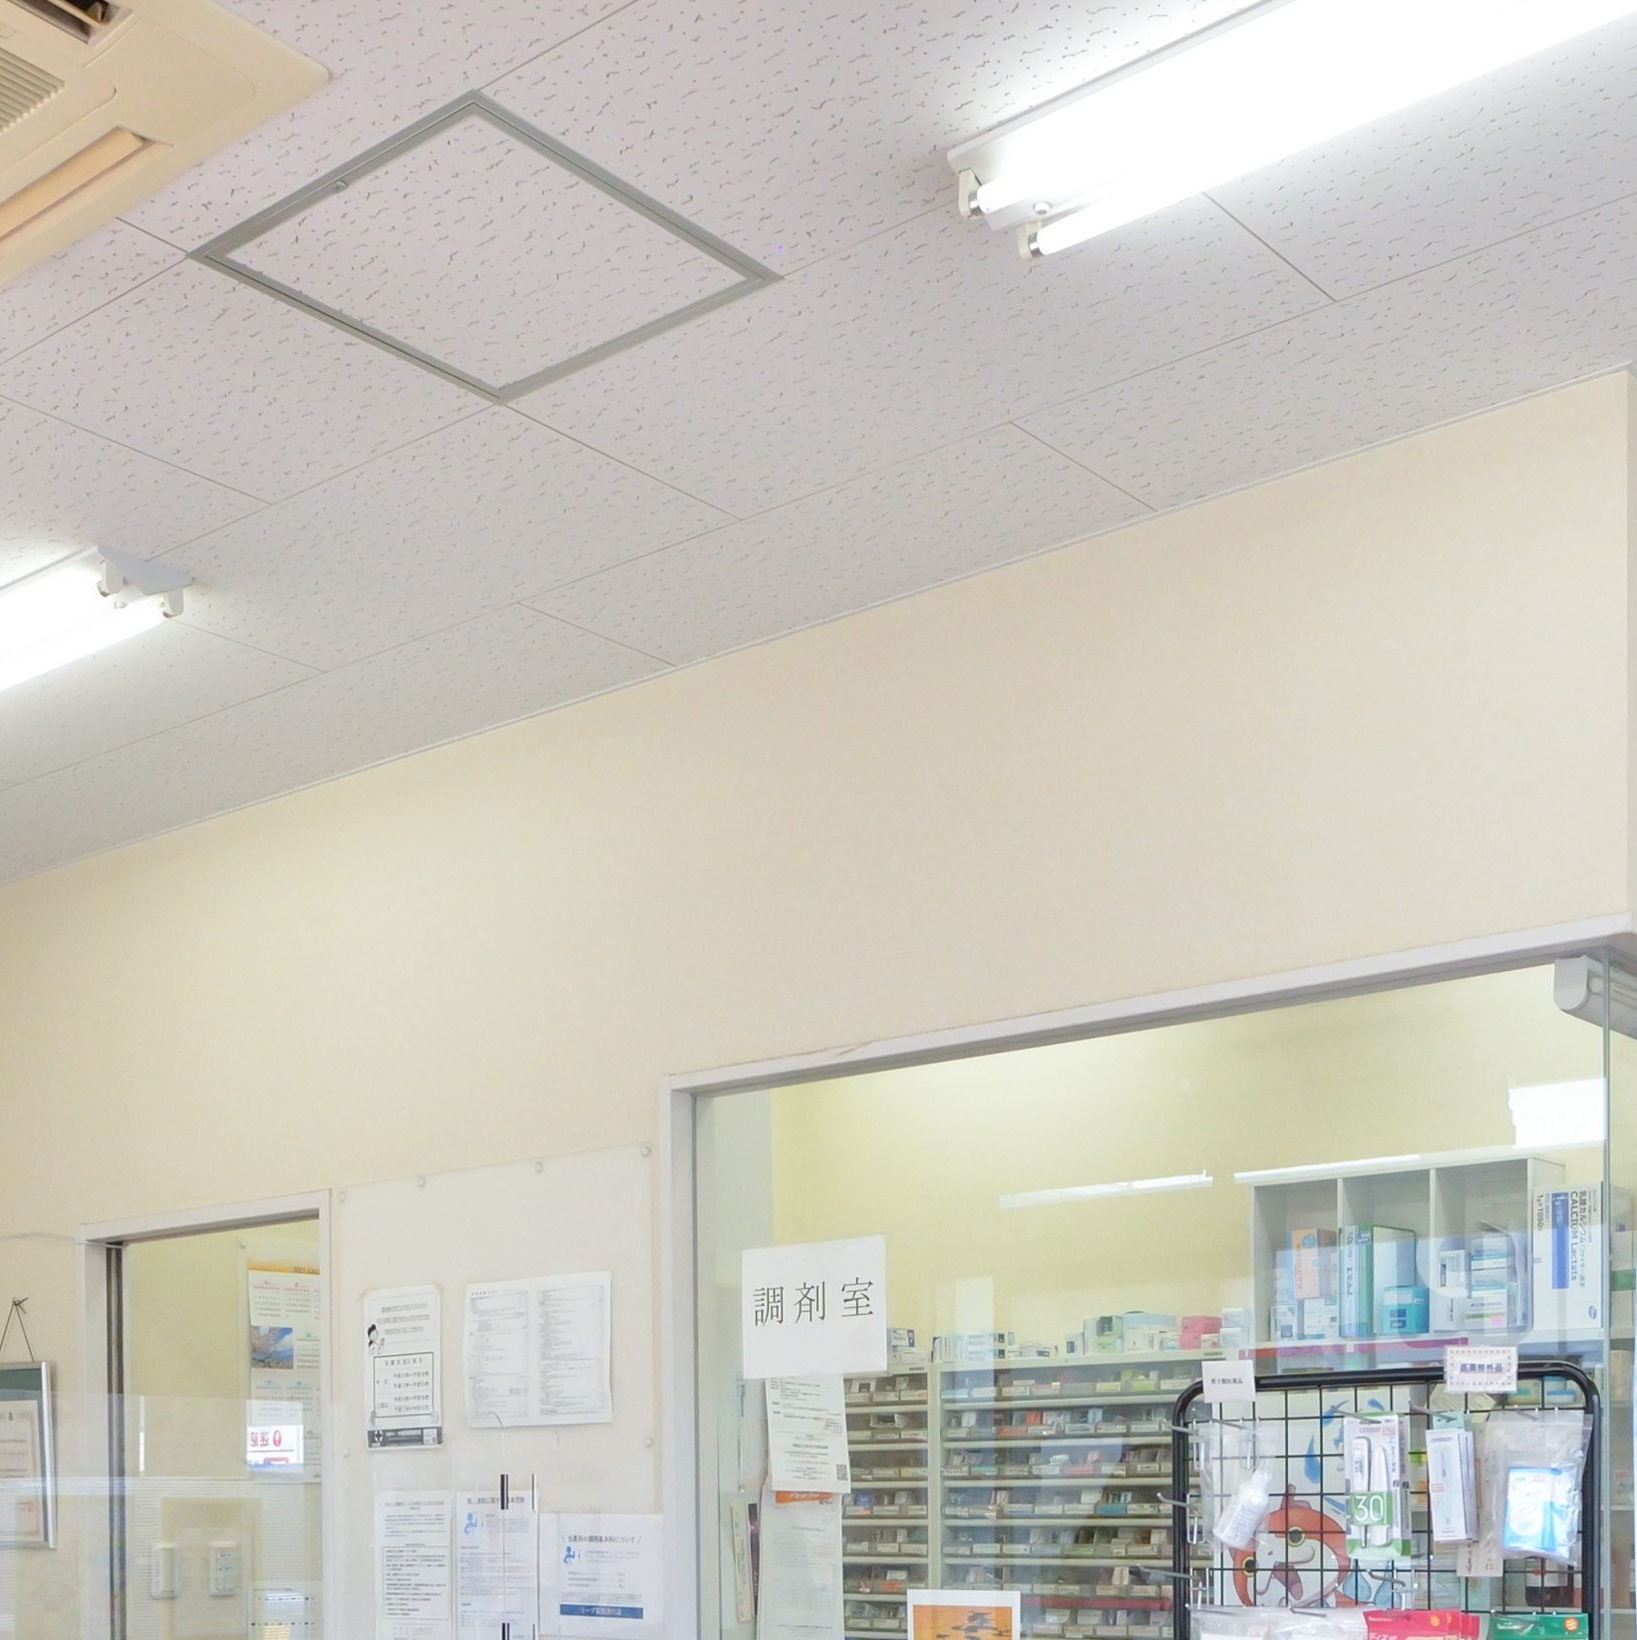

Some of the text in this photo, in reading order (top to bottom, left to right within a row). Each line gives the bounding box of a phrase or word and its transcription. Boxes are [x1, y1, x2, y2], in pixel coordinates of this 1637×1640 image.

[1570, 1190, 1579, 1281] CALCIUM Lactate
[753, 1277, 874, 1327] 調剤室
[1461, 1363, 1504, 1373] 医薬部外品
[1355, 1494, 1384, 1522] 30
